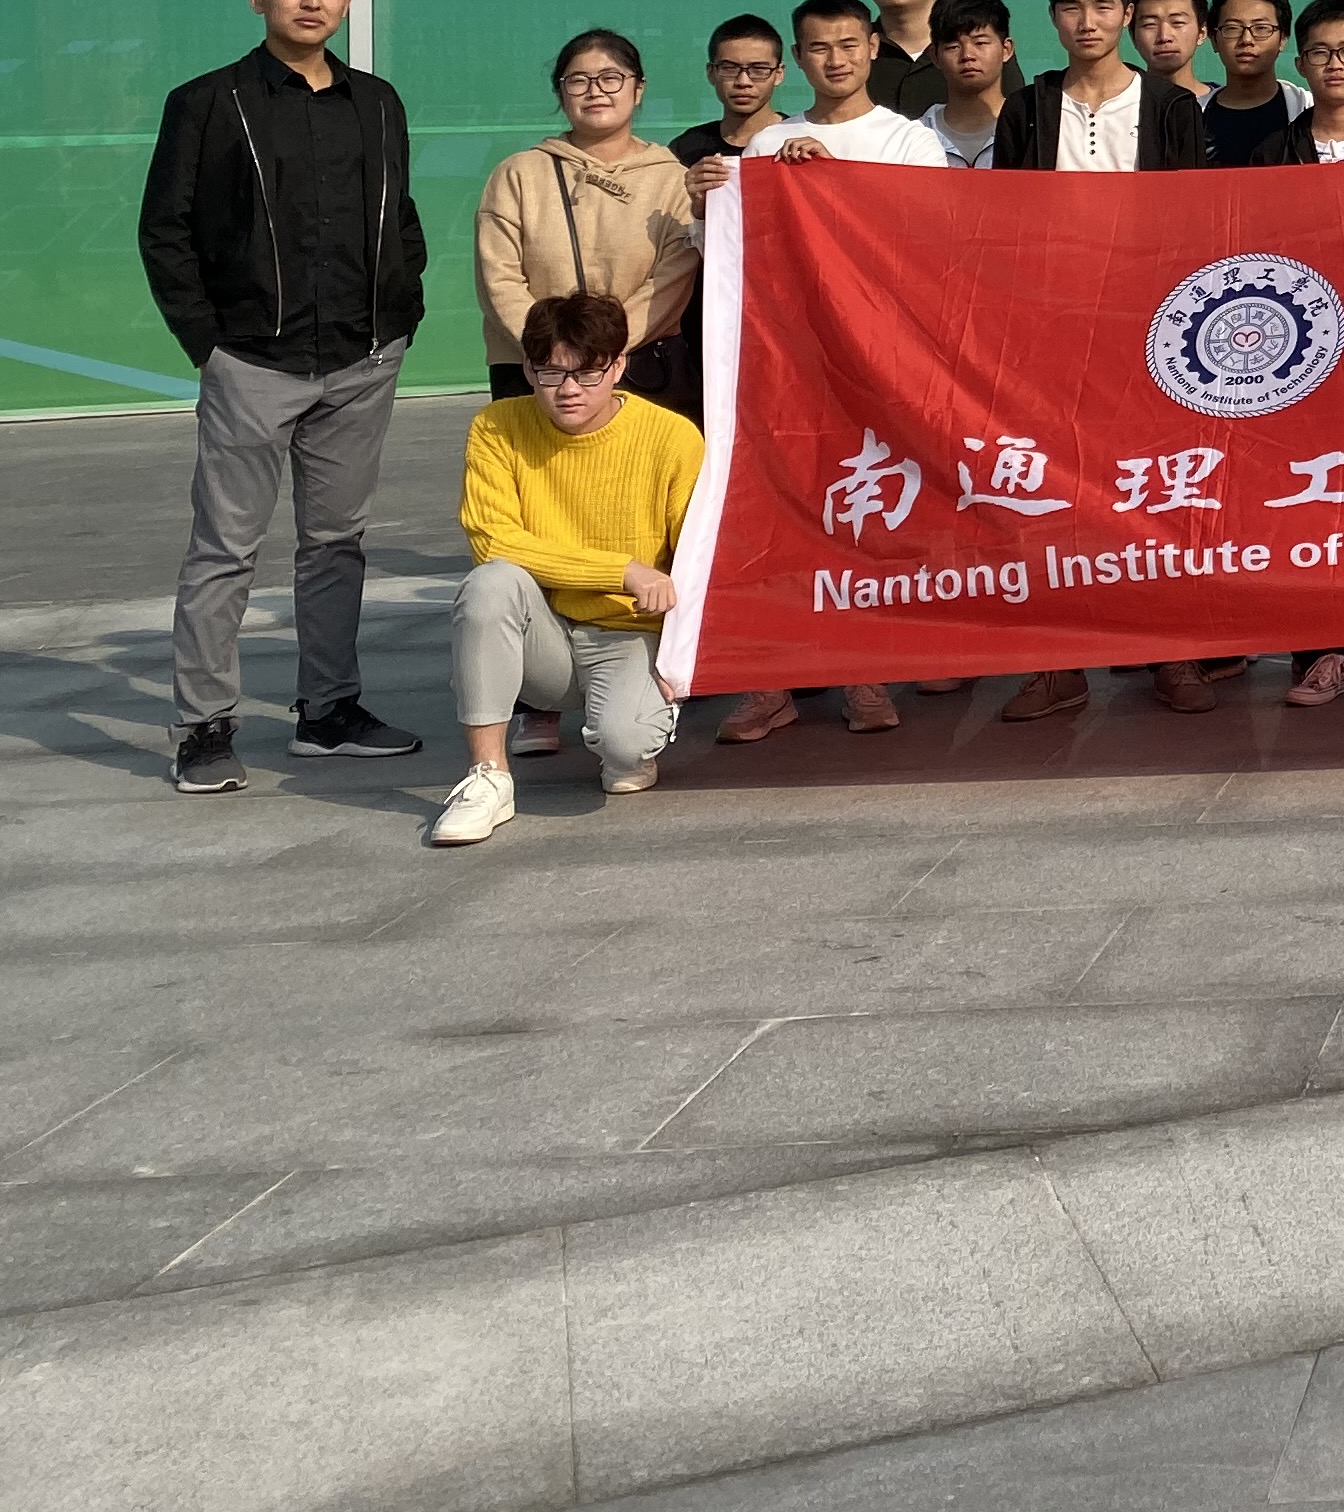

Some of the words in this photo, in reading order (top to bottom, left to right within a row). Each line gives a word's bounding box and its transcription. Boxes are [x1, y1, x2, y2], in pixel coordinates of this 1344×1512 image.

[1165, 356, 1198, 395] Nantong
[1200, 390, 1253, 405] Institute
[1257, 392, 1270, 403] of
[1272, 346, 1329, 397] Technology
[1224, 374, 1265, 386] 2000
[813, 558, 1030, 613] Nantong
[1047, 533, 1271, 589] Institute
[1289, 526, 1344, 567] of
